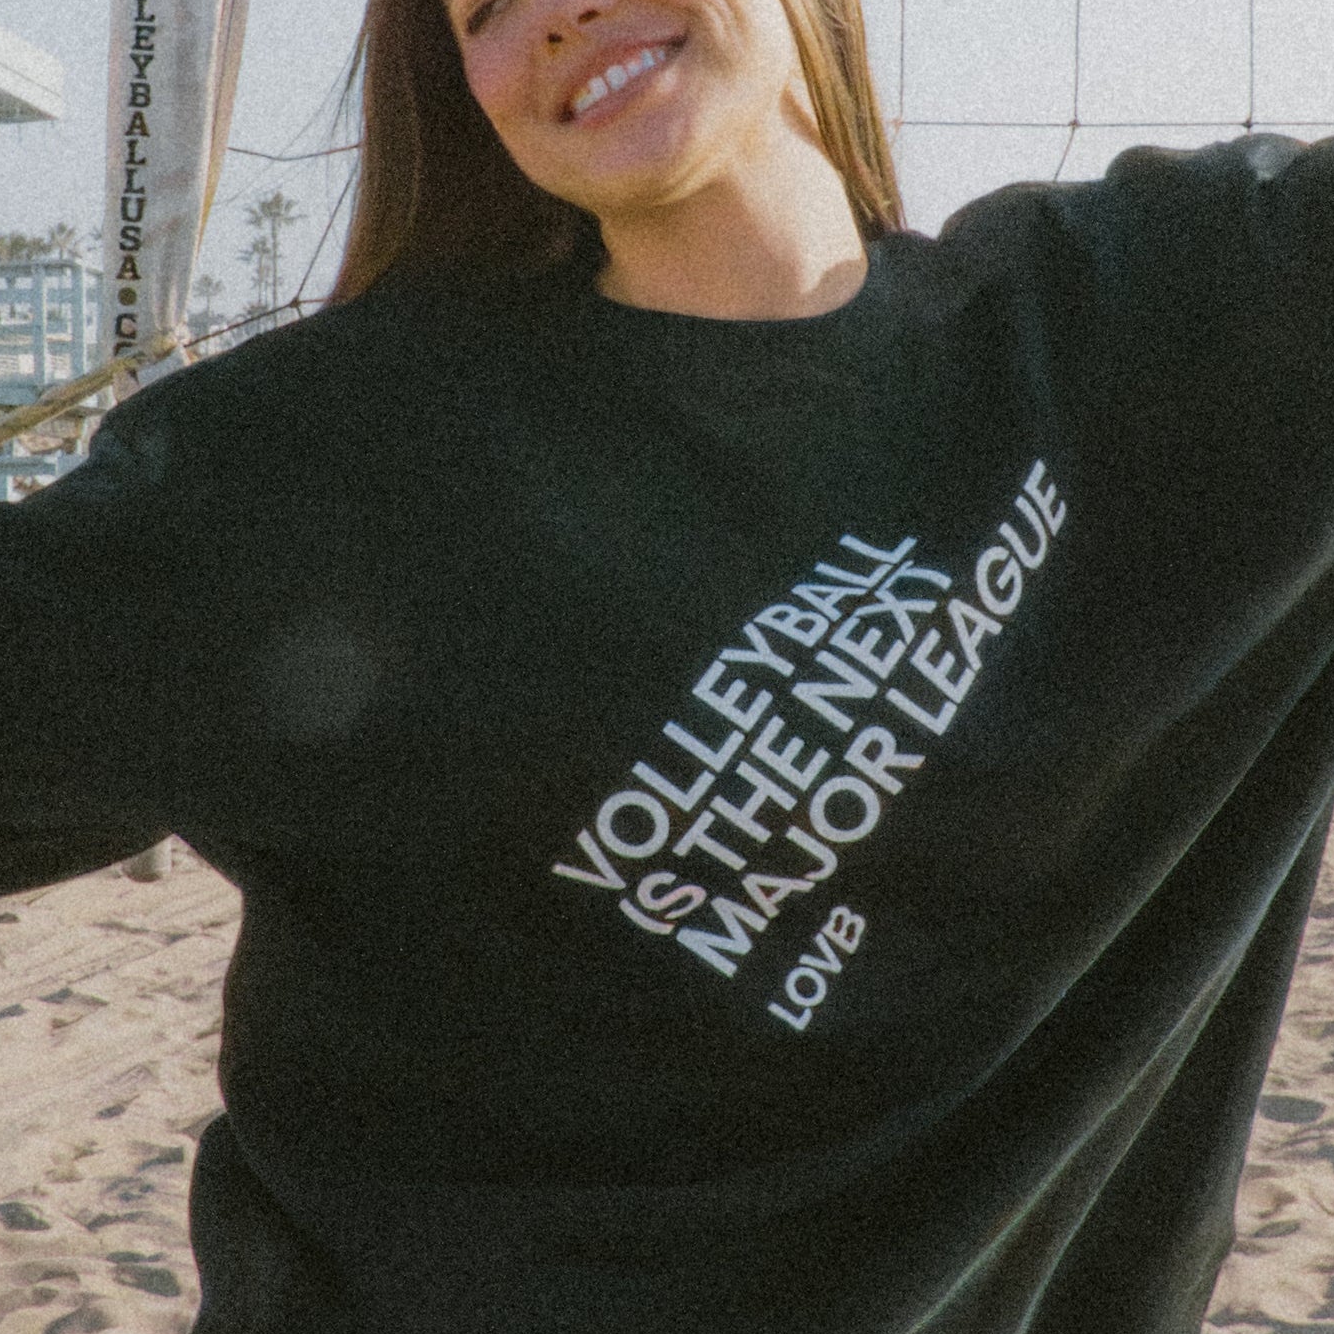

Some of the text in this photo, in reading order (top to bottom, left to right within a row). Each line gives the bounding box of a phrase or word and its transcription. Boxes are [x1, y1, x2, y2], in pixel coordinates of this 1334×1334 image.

[553, 534, 917, 890] VOLLEYBALL
[619, 559, 953, 935] IS THE NEXT
[676, 459, 1067, 978] MAJOR LEAGUE
[768, 905, 866, 1031] LOVB
